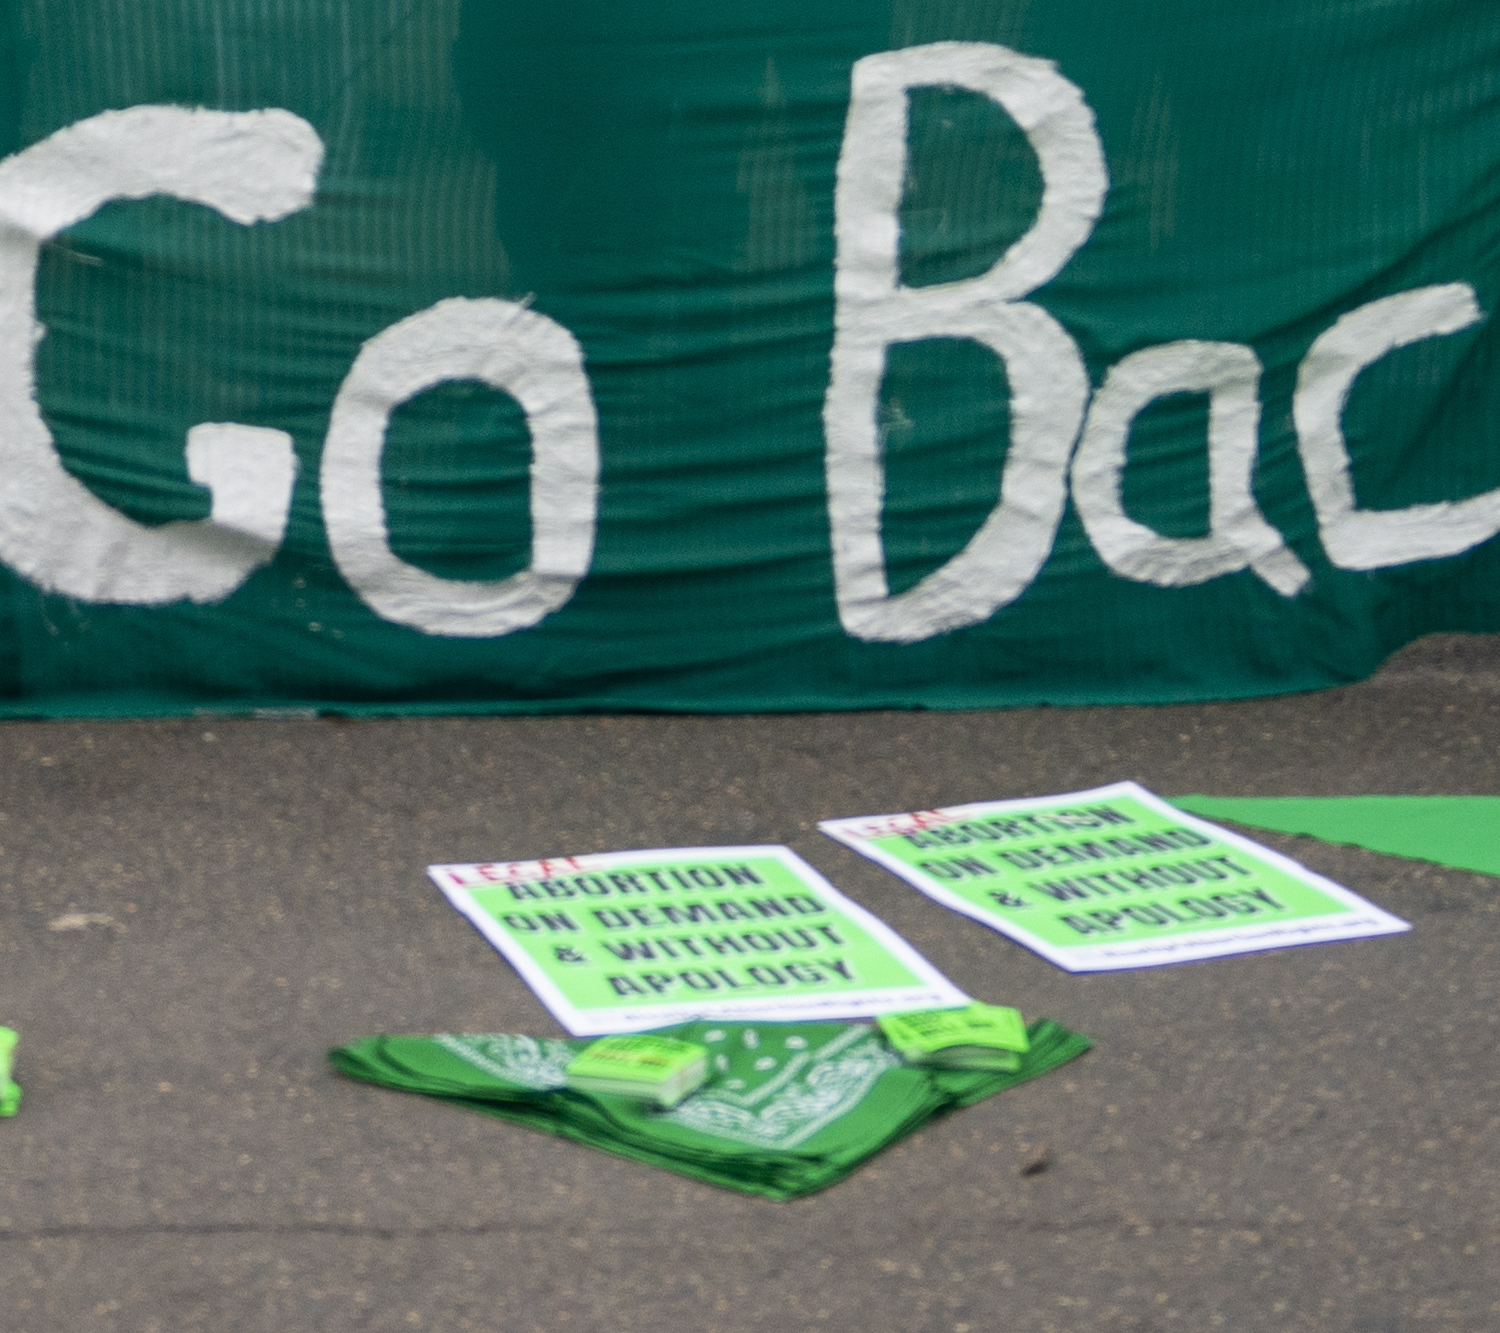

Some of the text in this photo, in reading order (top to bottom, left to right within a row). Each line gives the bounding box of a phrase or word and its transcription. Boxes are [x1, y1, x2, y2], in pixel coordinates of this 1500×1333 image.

[905, 803, 1138, 851] ABORTION
[920, 828, 1217, 881] ON DEMAND
[505, 860, 765, 902] ABORTION
[989, 855, 1253, 911] & WITHOUT
[502, 891, 829, 933] ON DEMAND
[1059, 886, 1288, 937] APOLOGY
[554, 925, 847, 964] & WITHOUT
[607, 959, 858, 998] APOLOGY
